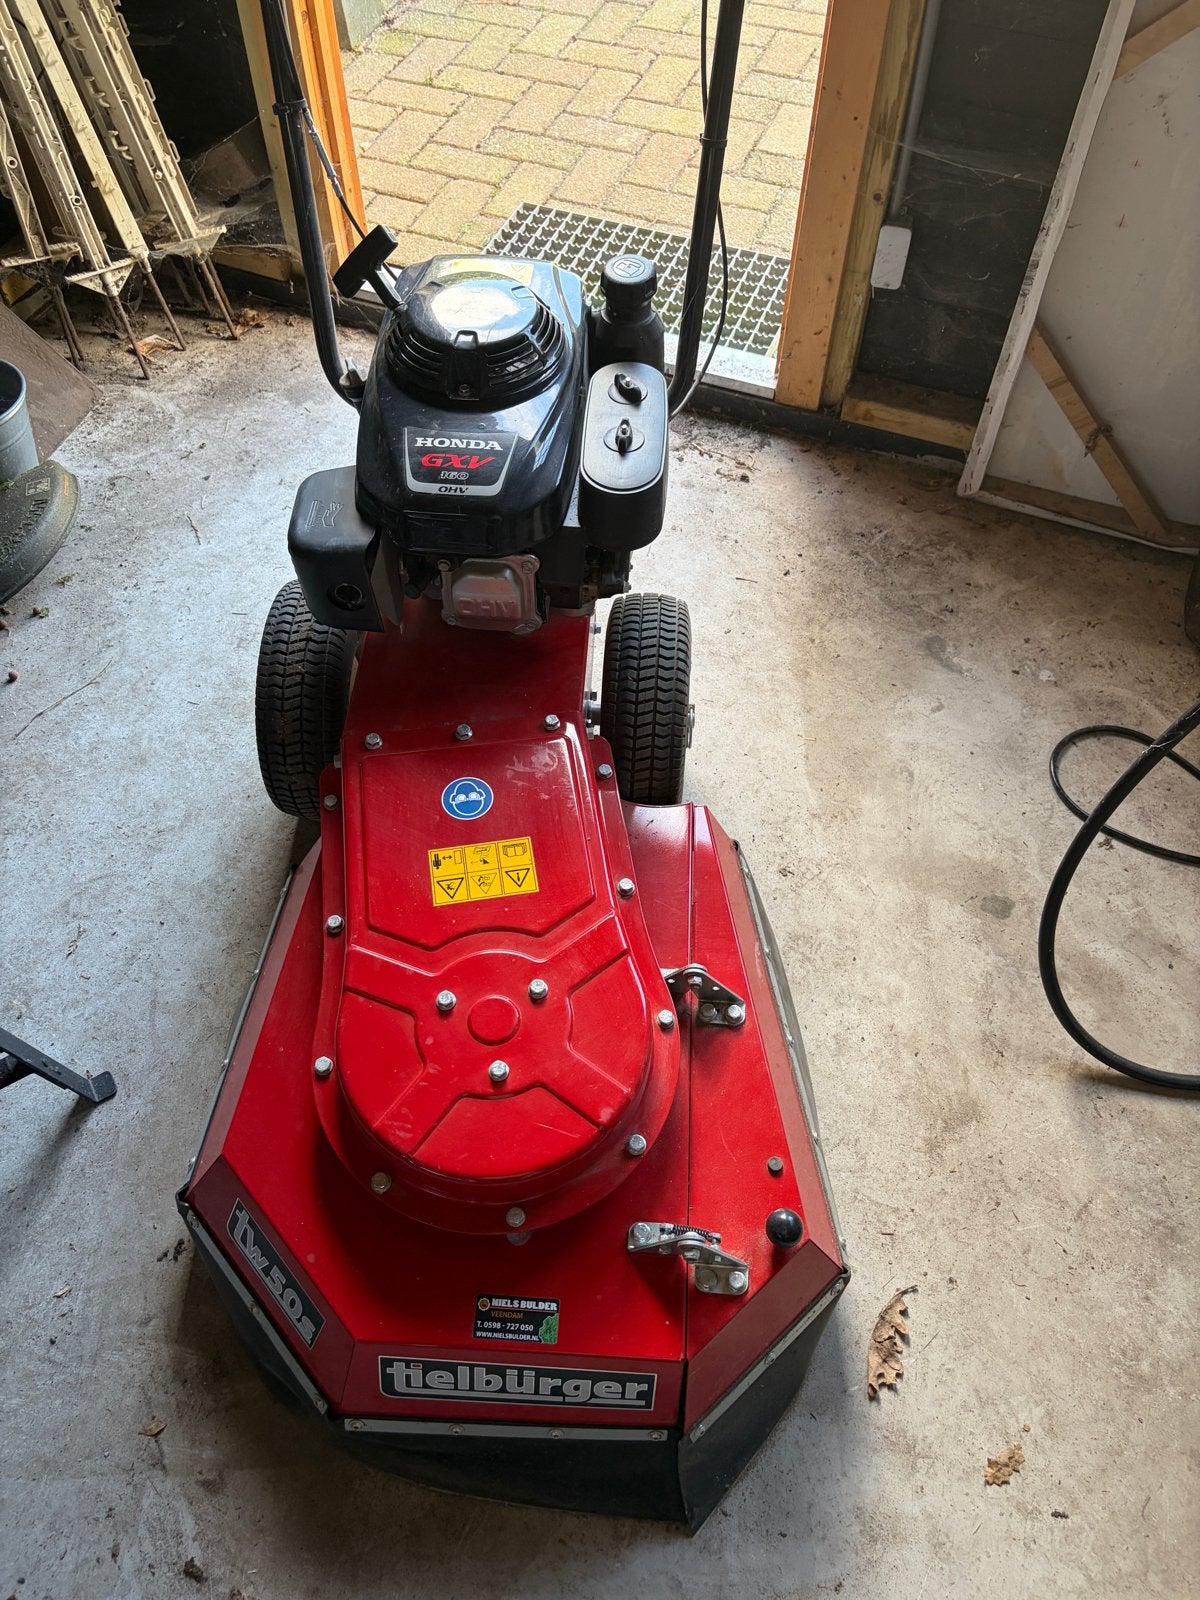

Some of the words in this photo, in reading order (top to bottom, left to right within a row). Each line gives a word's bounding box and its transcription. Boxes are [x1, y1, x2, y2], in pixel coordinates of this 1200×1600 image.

[414, 437, 503, 450] HONDA
[421, 453, 496, 469] GXV
[440, 471, 469, 480] 160
[438, 486, 469, 494] OHV
[492, 1298, 519, 1308] NIELS
[520, 1300, 557, 1310] BULDER
[491, 1311, 523, 1319] VEENDAM
[483, 1321, 501, 1329] 0598
[506, 1322, 519, 1331] 727
[476, 1331, 539, 1341] WWW.NIELSBULDER.NL
[386, 1361, 649, 1406] tielbürger
